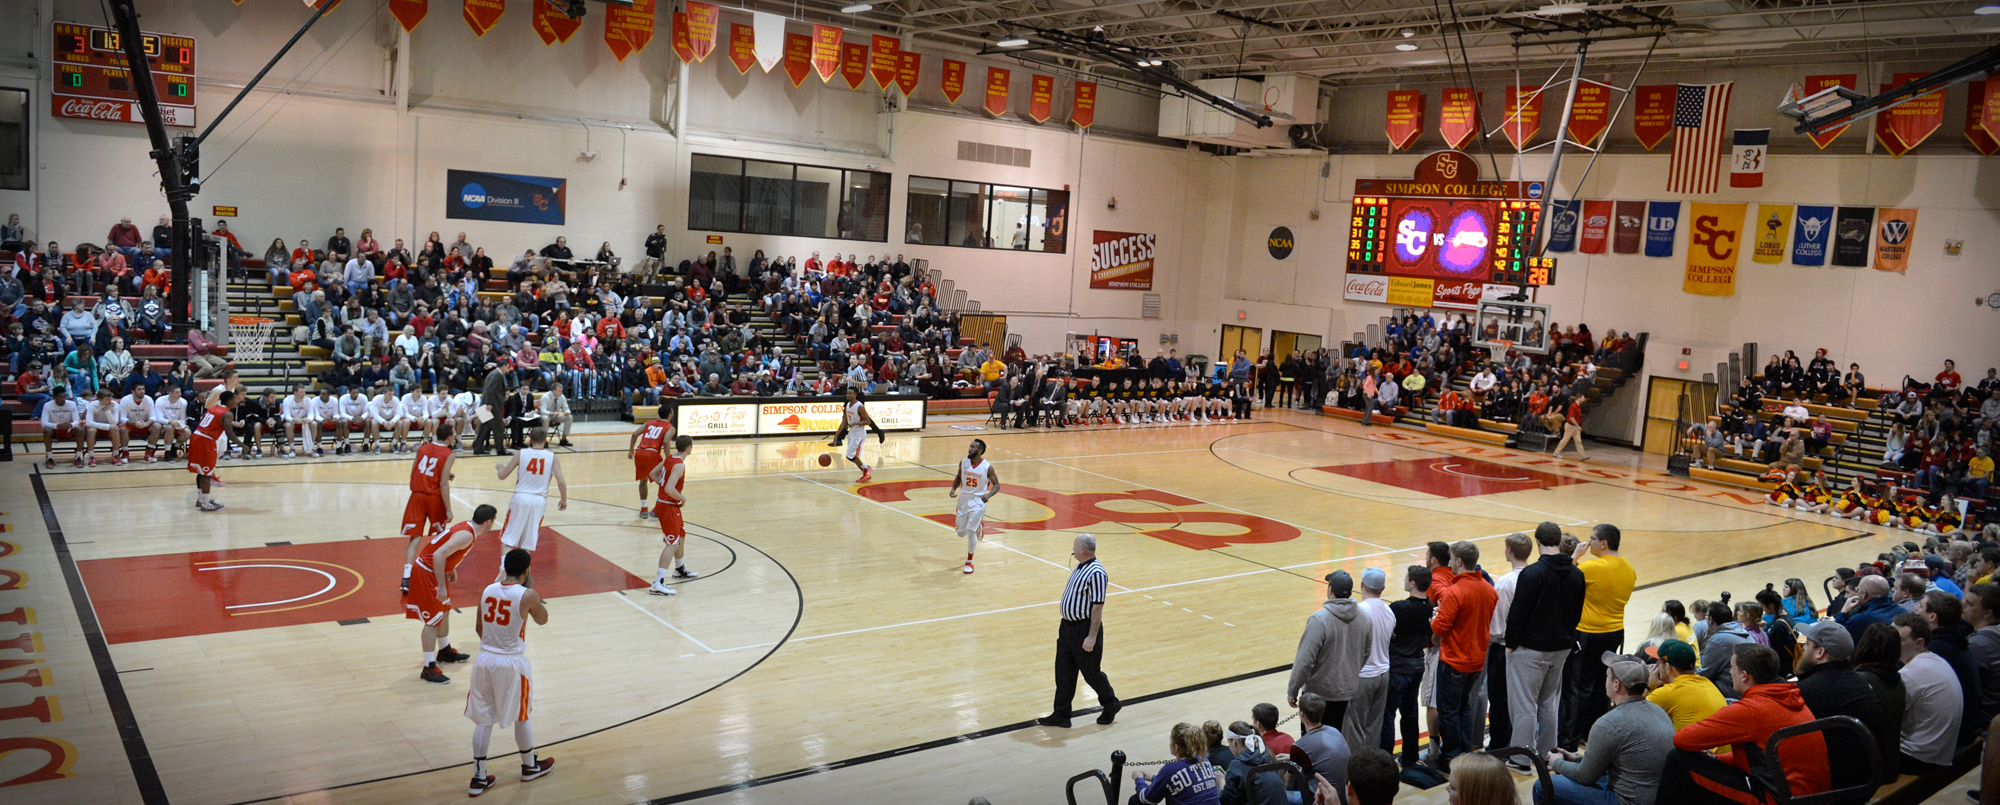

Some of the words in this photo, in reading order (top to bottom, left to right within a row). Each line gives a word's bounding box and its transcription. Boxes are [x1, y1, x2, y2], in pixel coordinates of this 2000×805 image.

[694, 7, 710, 16] 2010
[56, 25, 87, 35] HOME
[821, 30, 836, 38] 2012
[74, 36, 85, 53] 3
[162, 37, 193, 47] VISITOR
[813, 42, 840, 50] CHAMPIONS
[879, 40, 893, 48] 2013
[67, 54, 89, 62] BONUS
[179, 48, 190, 64] 0
[62, 65, 82, 73] FOULS
[103, 69, 127, 77] PLAYER
[162, 64, 182, 72] BONUS
[72, 73, 81, 87] 0
[178, 84, 187, 96] 0
[61, 99, 123, 120] Coca-Cola
[1436, 153, 1458, 178] SC
[1386, 183, 1440, 194] SIMPSON
[1444, 184, 1508, 196] COLLEGE
[463, 194, 485, 203] NCAA
[487, 196, 512, 204] Division
[533, 194, 548, 210] SC
[1356, 207, 1364, 215] 11
[1370, 206, 1376, 216] 0
[1382, 207, 1388, 216] 0
[1353, 217, 1362, 227] 25
[1368, 218, 1374, 227] 0
[1380, 218, 1387, 228] 0
[1498, 223, 1510, 233] 30
[1352, 229, 1362, 238] 31
[1367, 229, 1373, 238] 0
[1379, 230, 1386, 239] 0
[1397, 219, 1426, 255] SC
[1693, 215, 1735, 260] SC
[1881, 221, 1912, 243] W
[1269, 238, 1292, 248] NCAA
[1433, 233, 1444, 245] VS
[1497, 235, 1509, 246] 34
[1350, 240, 1360, 249] 35
[1366, 241, 1372, 250] 0
[1378, 241, 1384, 250] 3
[1092, 234, 1155, 272] SUCCESS
[1350, 251, 1359, 260] 41
[1365, 252, 1371, 261] 0
[1377, 252, 1383, 262] 0
[1496, 248, 1507, 258] 40
[1494, 260, 1506, 270] 42
[1513, 261, 1520, 271] 0
[1689, 265, 1734, 275] SIMPSON
[1098, 266, 1128, 279] CHAMPIONSHIP
[1529, 268, 1548, 285] 28
[1347, 279, 1386, 296] Coca-Cola
[1413, 281, 1432, 289] Jones
[1435, 284, 1462, 299] Sports
[1462, 283, 1482, 298] Page
[763, 404, 807, 415] SIMPSON
[688, 410, 722, 428] Sports
[798, 417, 840, 431] STORM
[645, 425, 663, 439] 30
[418, 455, 438, 477] 42
[526, 458, 545, 475] 41
[966, 478, 978, 487] 25
[483, 596, 512, 626] 35
[1166, 768, 1192, 796] LSU
[1192, 782, 1206, 793] EST.
